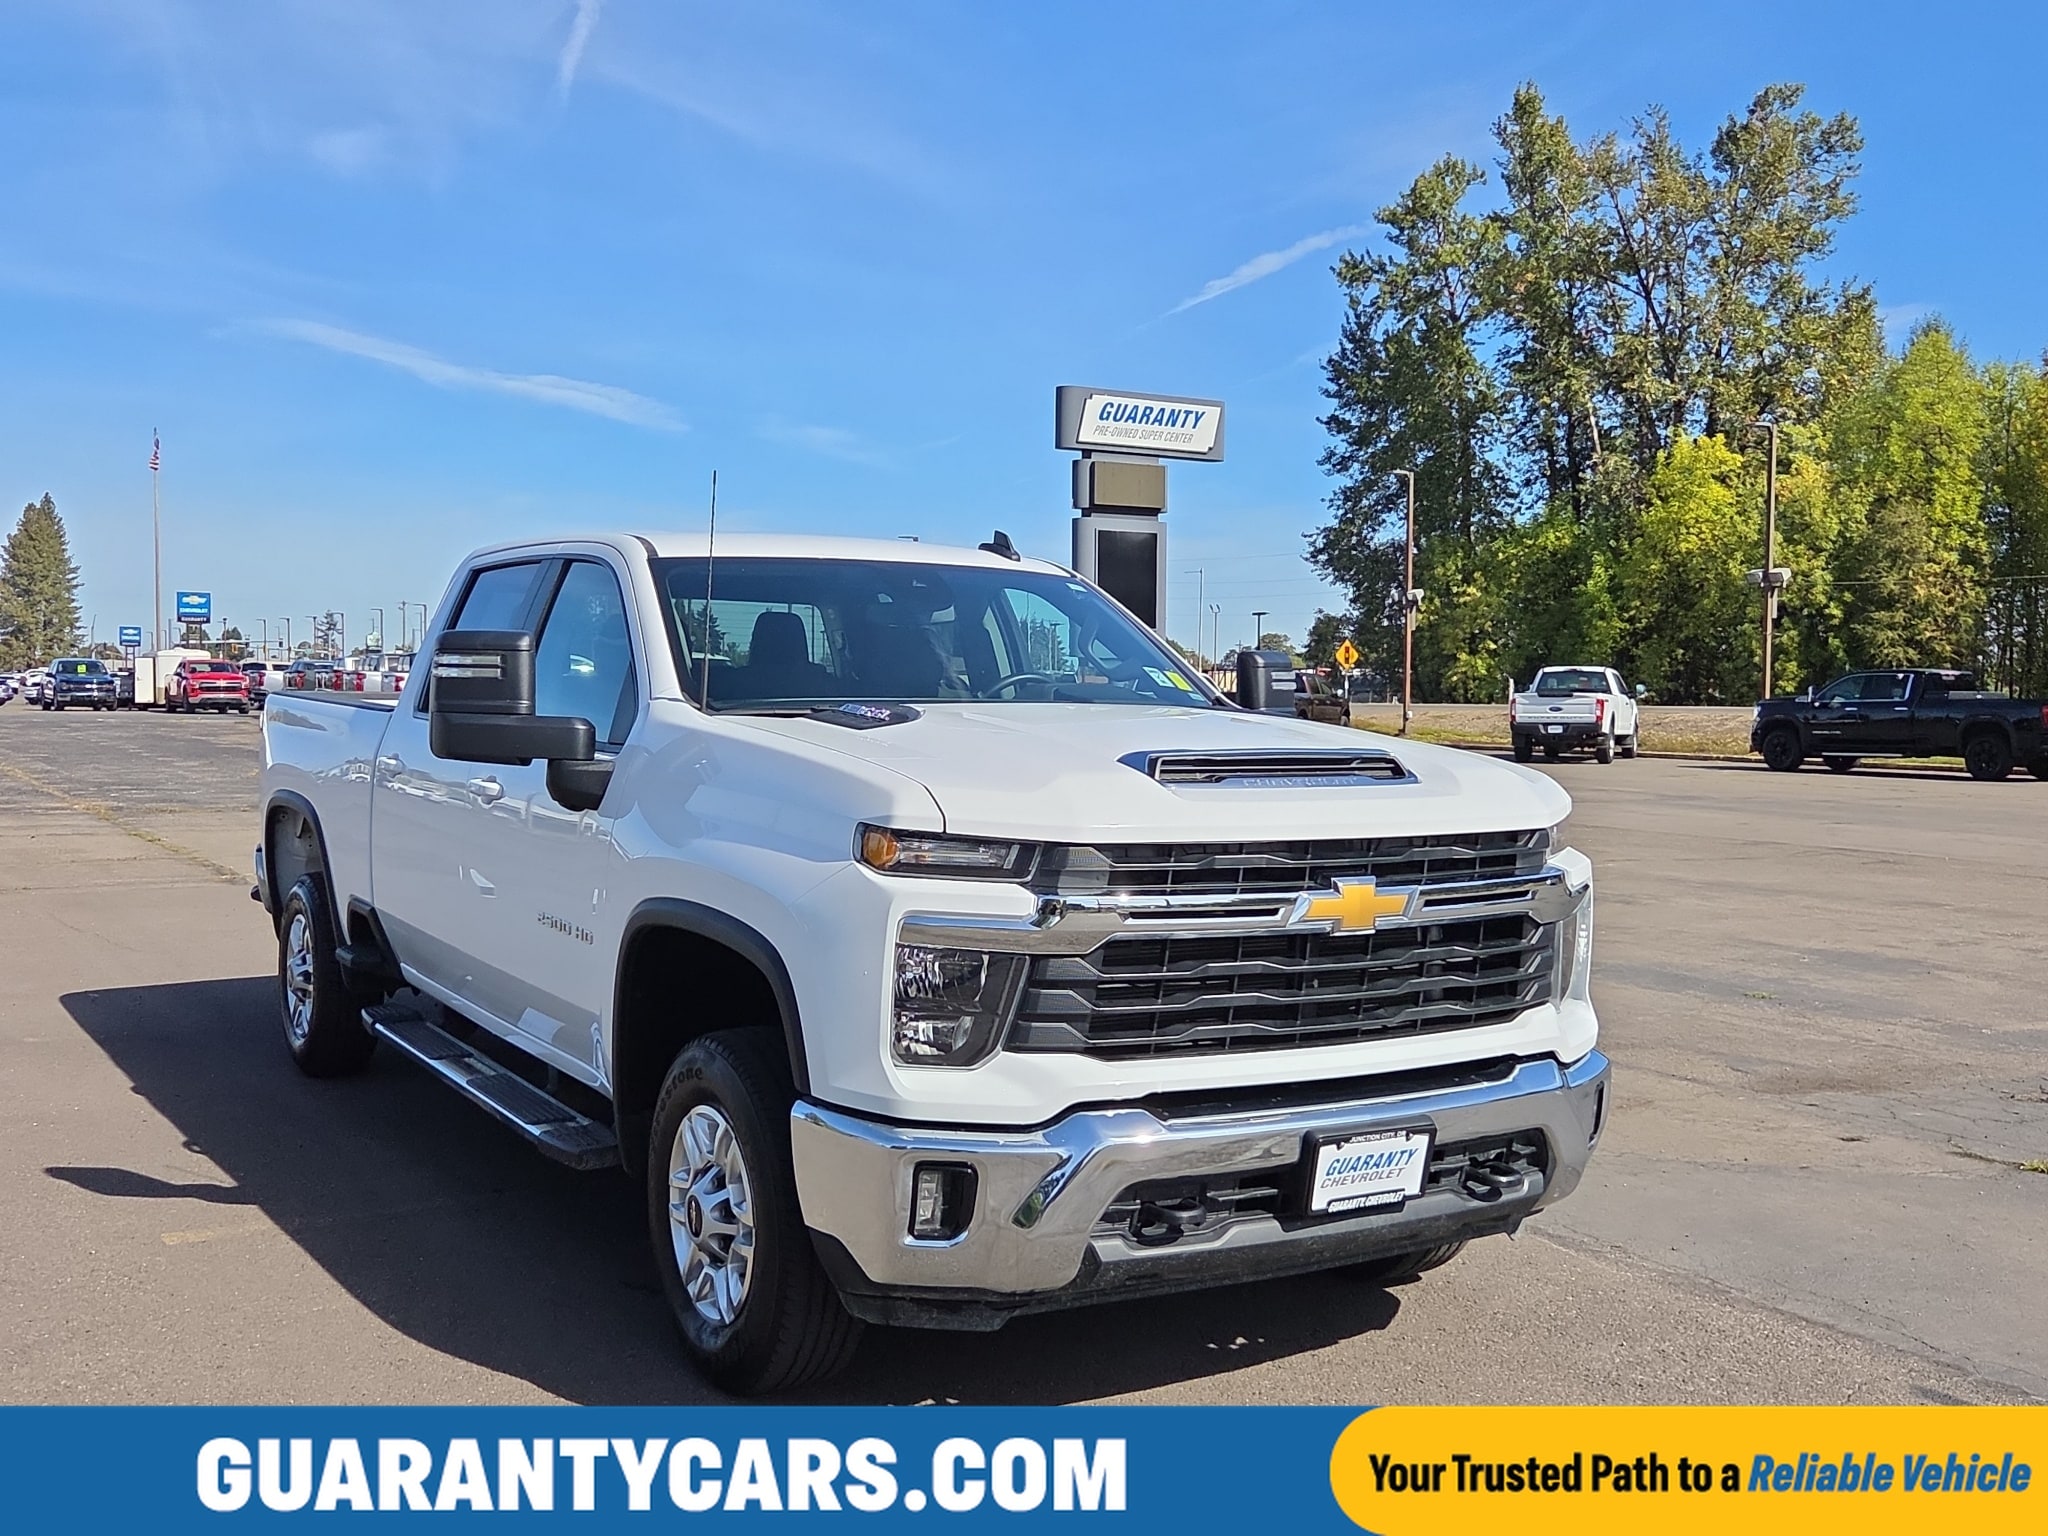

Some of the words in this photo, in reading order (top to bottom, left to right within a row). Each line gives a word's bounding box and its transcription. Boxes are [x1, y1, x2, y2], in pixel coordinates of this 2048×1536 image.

[1099, 402, 1206, 429] GUARANTY
[1093, 425, 1138, 440] PRE-OWNED
[1138, 430, 1164, 441] SUPER
[1164, 431, 1194, 444] CENTER
[1349, 1133, 1381, 1143] JUNCTION
[1325, 1148, 1419, 1177] GUARANTY
[1320, 1167, 1406, 1189] CHEVROLET
